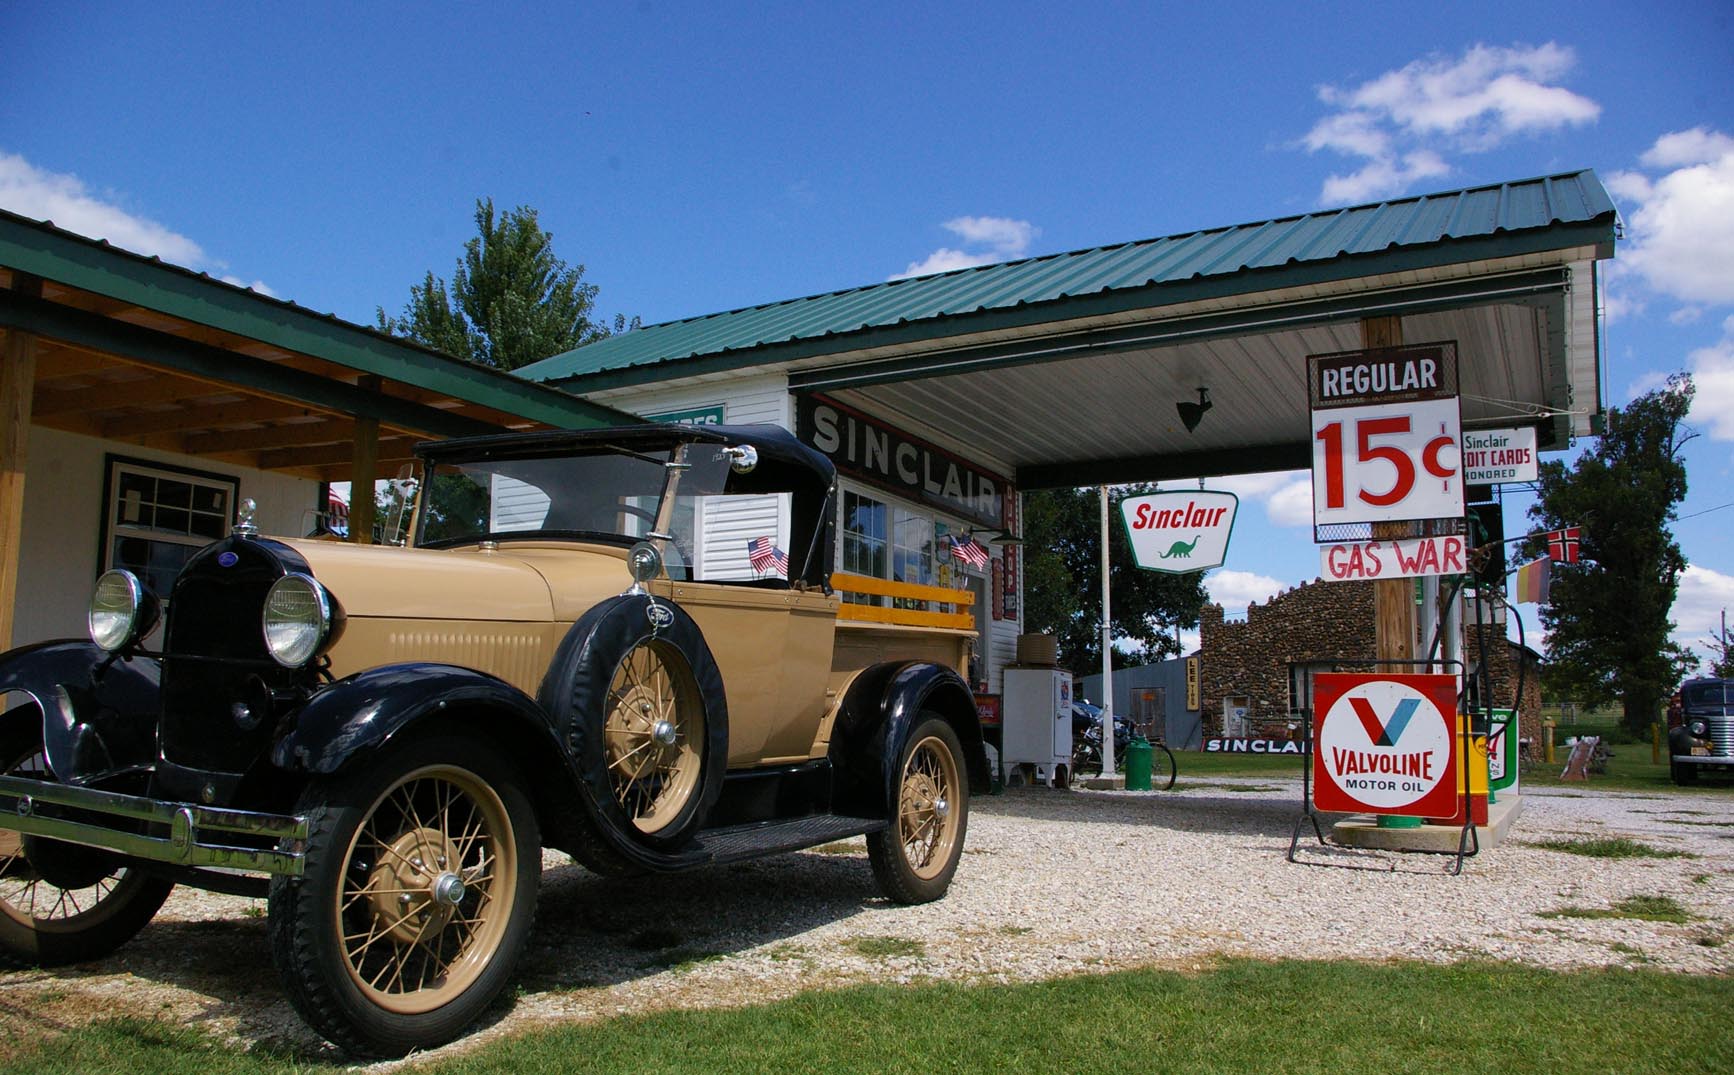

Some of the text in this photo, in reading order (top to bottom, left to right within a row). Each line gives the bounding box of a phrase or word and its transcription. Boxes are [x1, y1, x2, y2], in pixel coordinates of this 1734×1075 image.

[1322, 358, 1437, 397] REGULAR
[1465, 434, 1509, 449] Sinclair
[812, 406, 996, 517] SINCLAIR
[1463, 448, 1530, 468] DIT CARDS
[1133, 501, 1227, 530] Sinclair
[1328, 537, 1463, 579] GAS WAR
[1207, 739, 1306, 754] SINCLAI
[1332, 746, 1434, 781] VALVOLINE
[1345, 779, 1425, 793] MOTOR OIL
